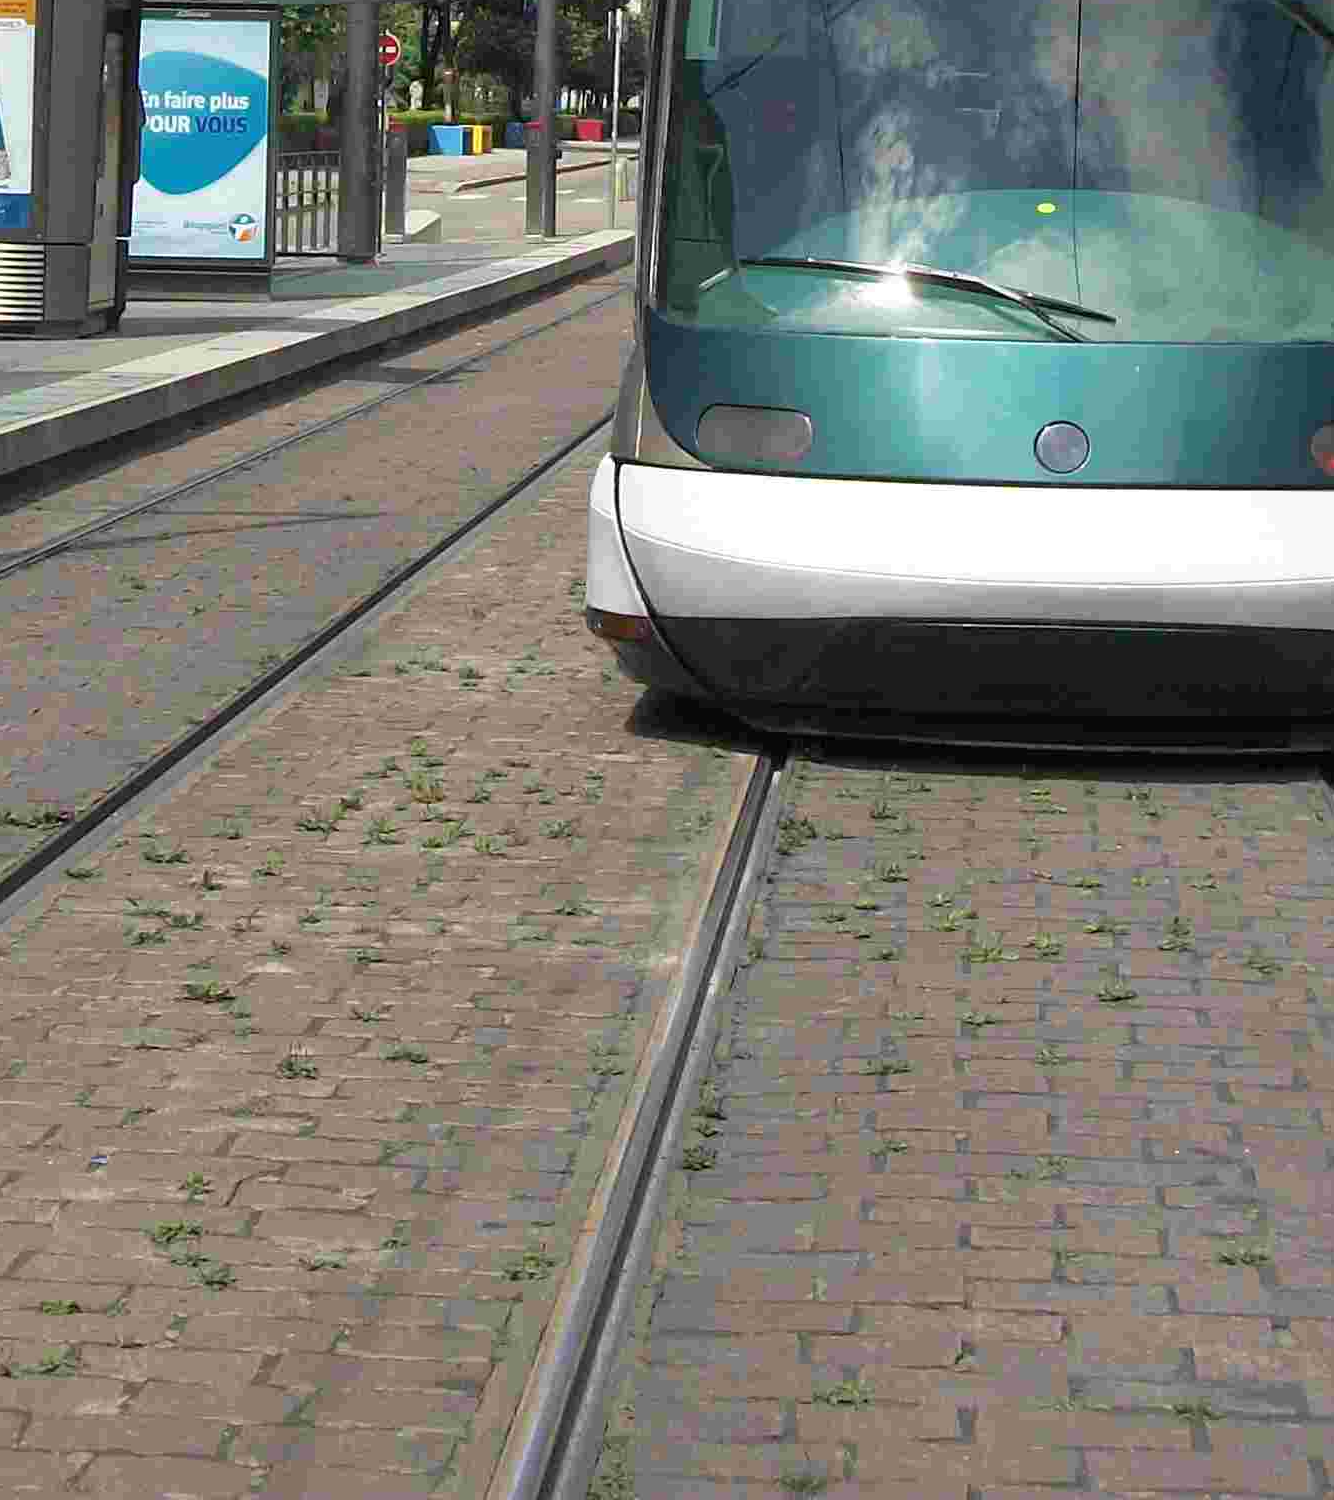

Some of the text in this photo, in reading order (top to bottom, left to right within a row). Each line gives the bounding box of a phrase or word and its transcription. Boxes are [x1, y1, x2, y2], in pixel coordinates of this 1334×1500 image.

[164, 89, 206, 109] faire
[209, 91, 251, 113] plus
[196, 115, 248, 133] VOUS
